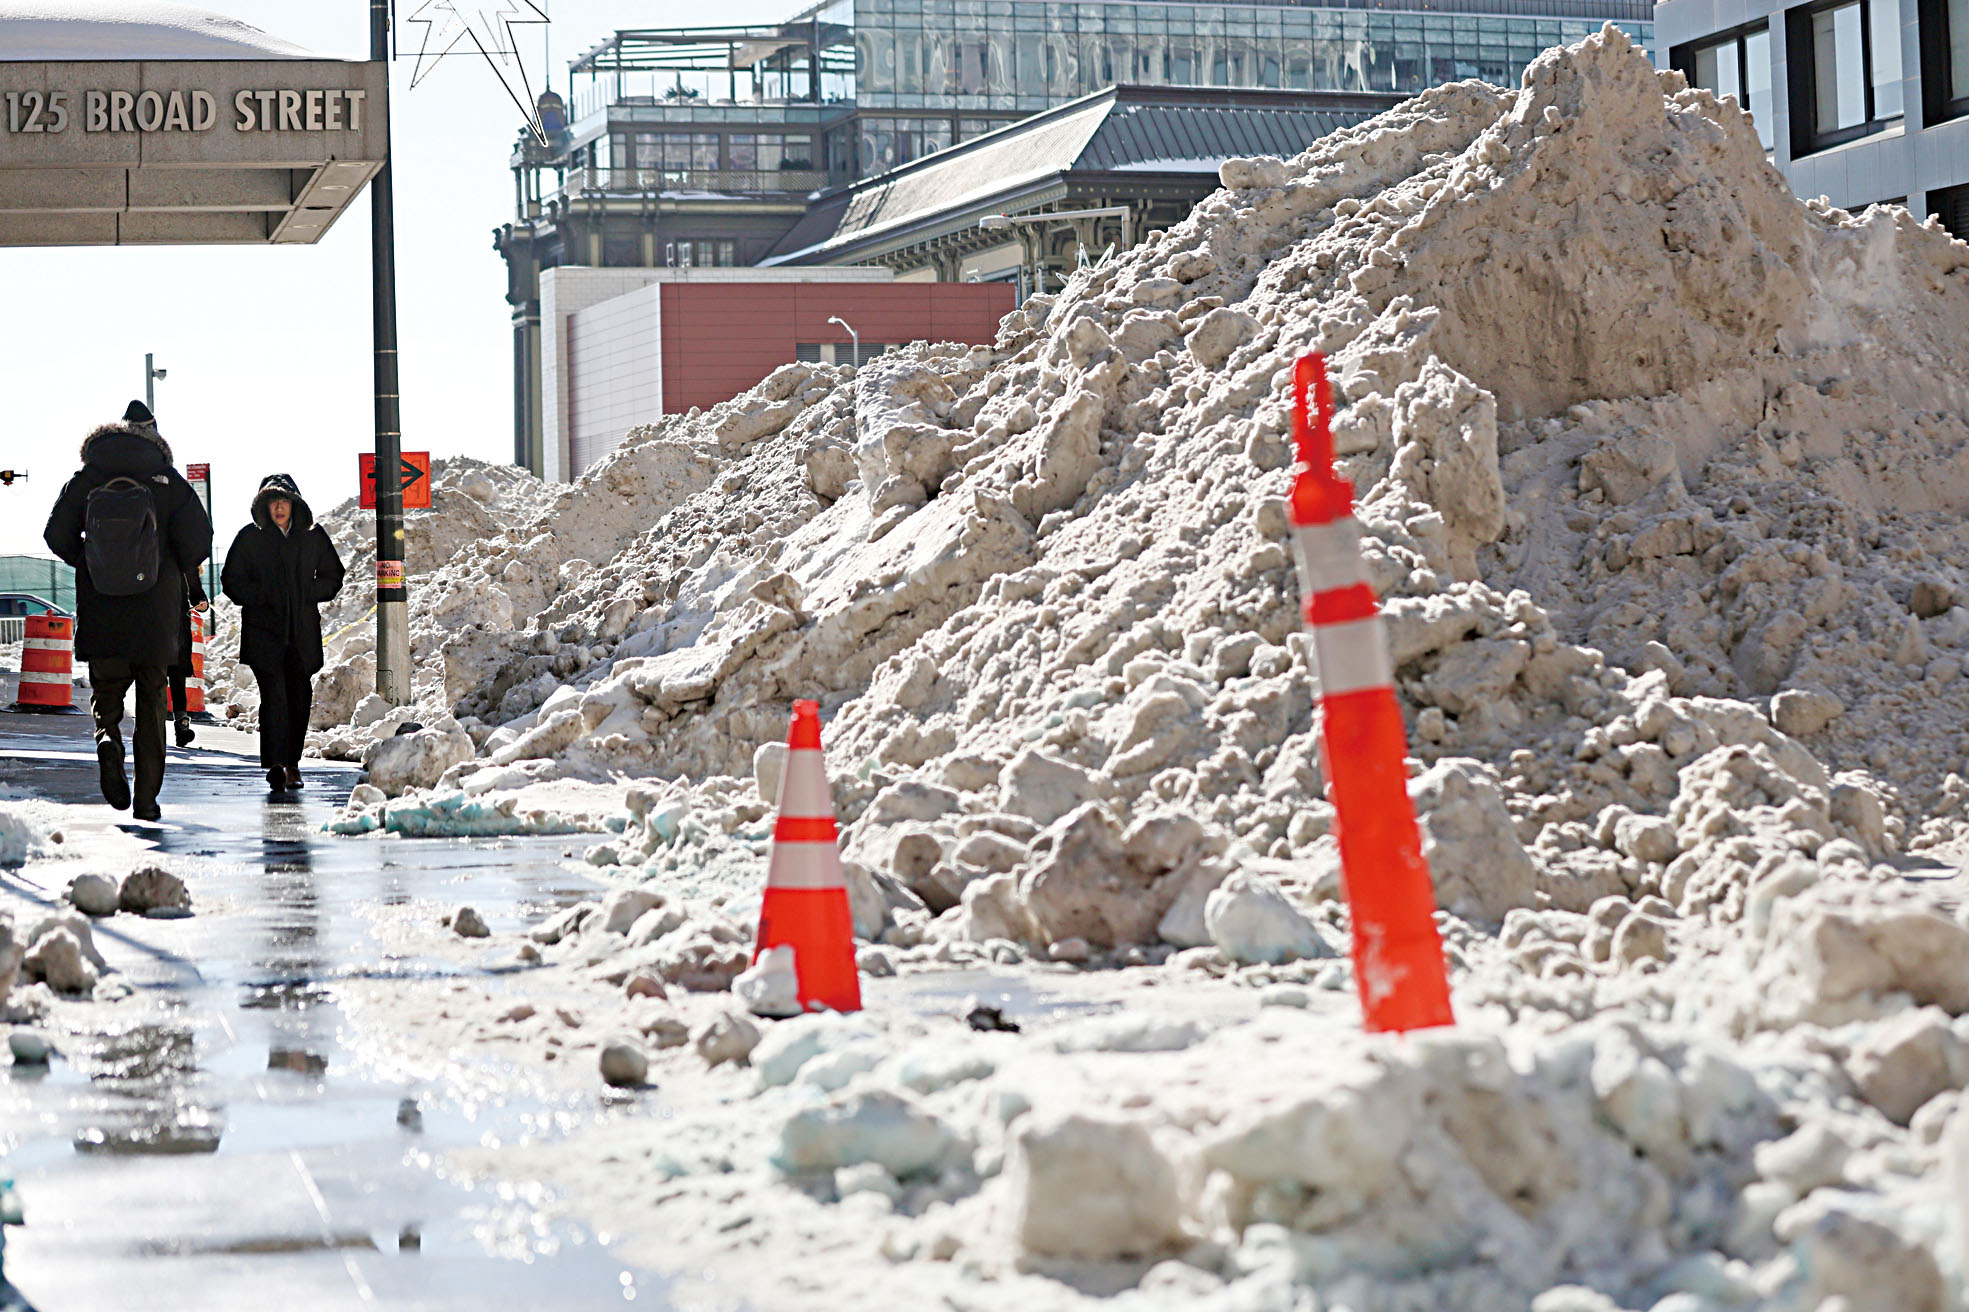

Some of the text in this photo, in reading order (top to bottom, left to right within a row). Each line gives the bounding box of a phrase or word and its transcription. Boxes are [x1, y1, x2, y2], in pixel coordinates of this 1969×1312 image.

[5, 90, 365, 133] 125 BROAD STREET
[377, 569, 400, 577] ARKING
